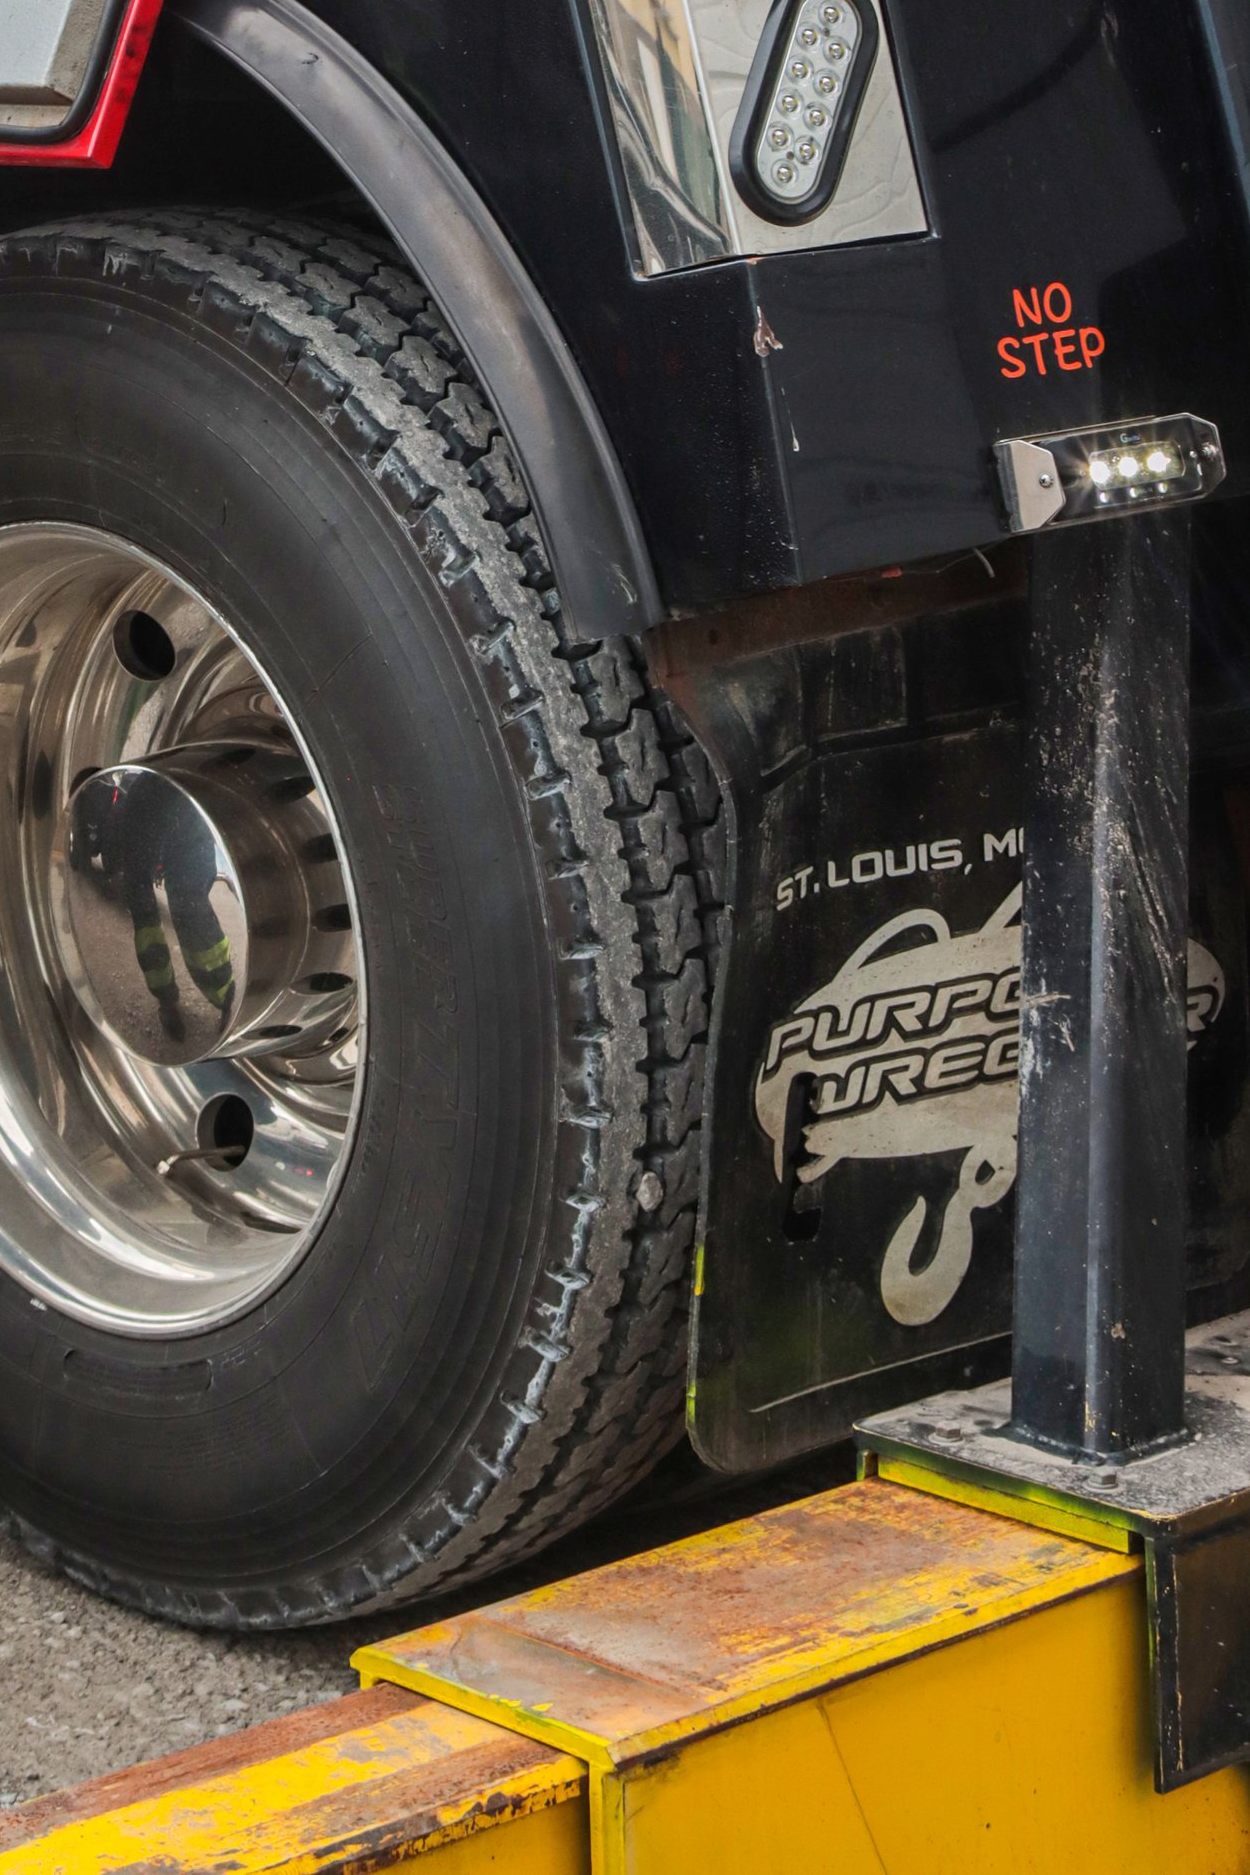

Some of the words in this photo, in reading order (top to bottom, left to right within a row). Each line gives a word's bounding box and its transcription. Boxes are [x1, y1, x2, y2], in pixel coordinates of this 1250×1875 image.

[1012, 282, 1072, 328] NO
[997, 327, 1105, 378] STEP
[776, 866, 820, 911] ST.
[827, 838, 973, 889] LOUIS,
[766, 977, 1021, 1071] PURP
